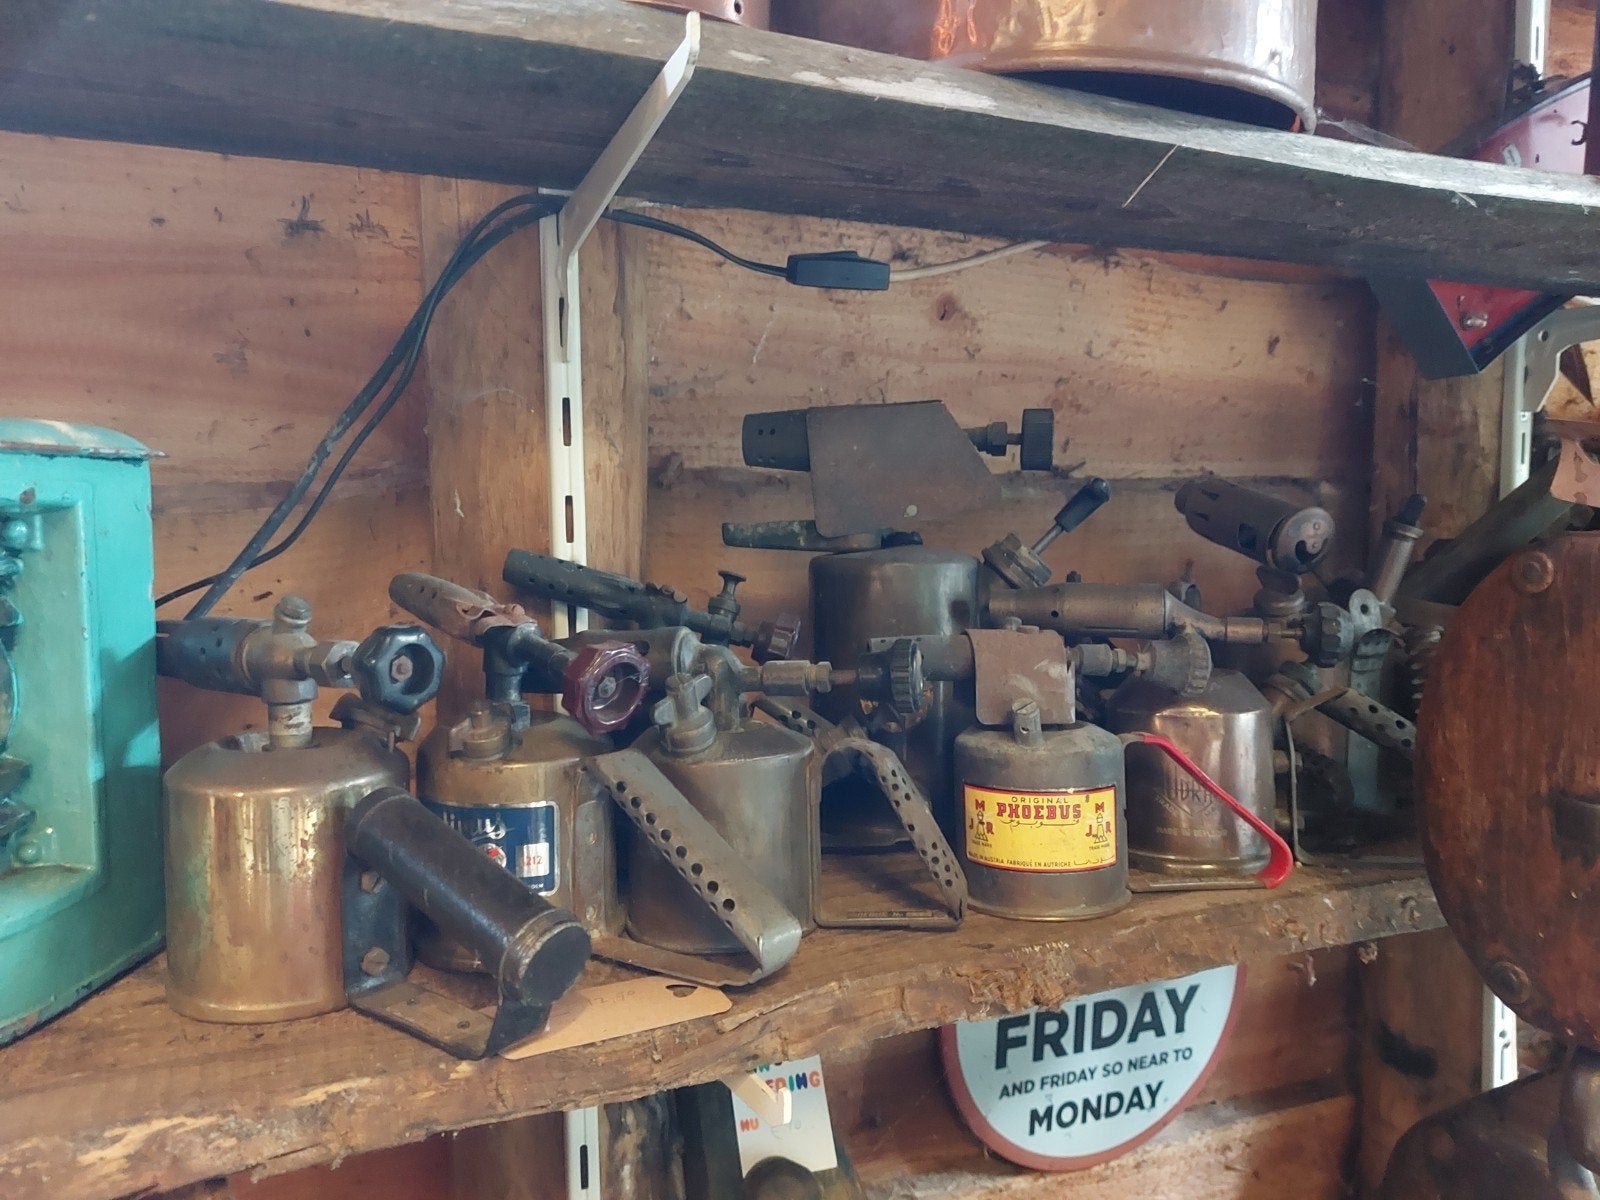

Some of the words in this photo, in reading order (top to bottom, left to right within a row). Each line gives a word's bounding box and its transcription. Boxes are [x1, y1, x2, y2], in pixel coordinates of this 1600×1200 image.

[975, 799, 985, 811] M
[996, 802, 1081, 820] PHOEBUS
[1011, 796, 1069, 804] ORIGINAL
[995, 984, 1200, 1070] FRIDAY
[999, 1080, 1034, 1100] AND
[1040, 1065, 1098, 1090] FRIDAY
[1102, 1061, 1123, 1077] SO
[1128, 1053, 1168, 1073] NEAR
[1174, 1047, 1193, 1062] TO
[1029, 1080, 1164, 1136] MONDAY
